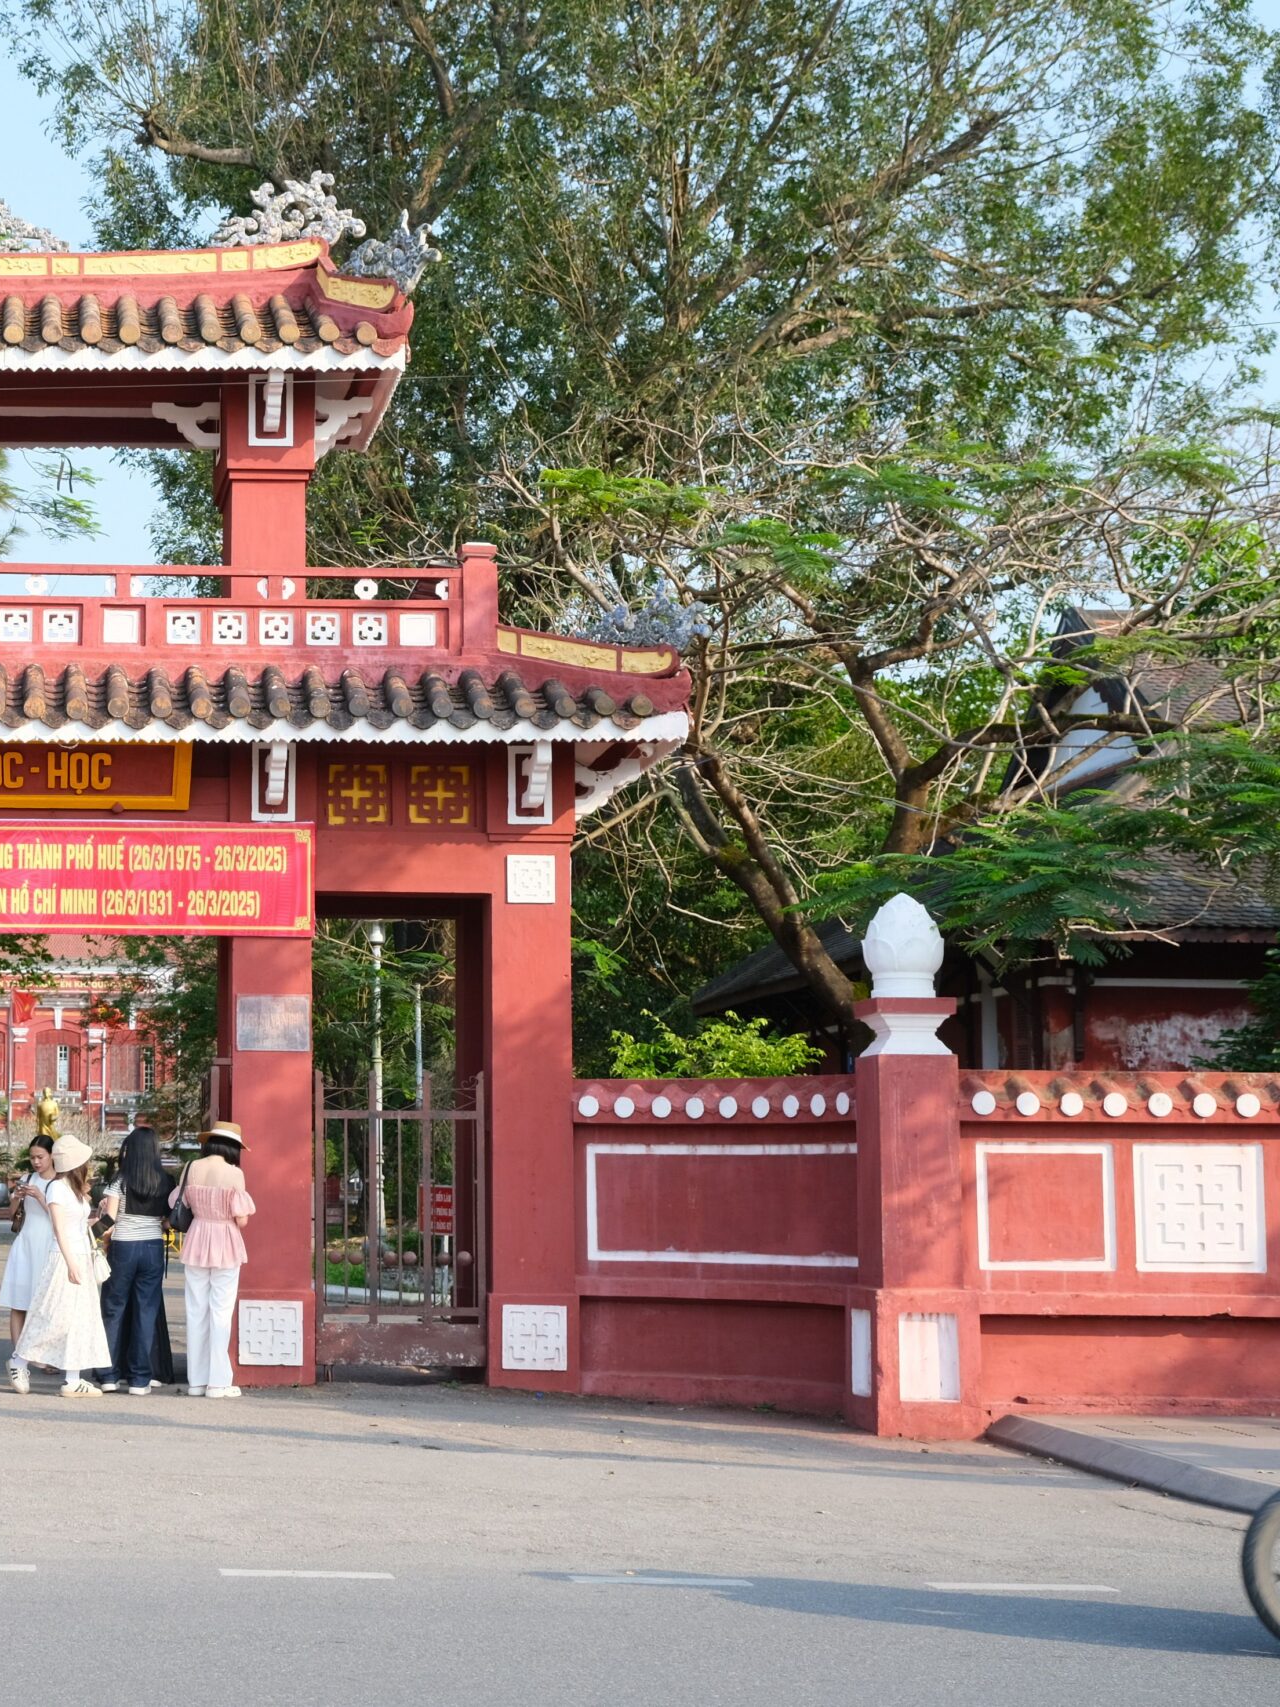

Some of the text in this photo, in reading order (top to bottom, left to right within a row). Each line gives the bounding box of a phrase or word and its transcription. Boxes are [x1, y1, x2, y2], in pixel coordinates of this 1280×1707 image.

[46, 751, 112, 795] HỌC
[17, 838, 62, 870] THÀNH
[66, 835, 94, 870] PHỐ
[98, 836, 125, 871] HUẾ
[129, 844, 201, 873] (26/3/1975
[214, 845, 287, 873] 26/3/2025)
[10, 880, 30, 915] HỒ
[33, 883, 57, 915] CHÍ
[60, 888, 97, 915] MINH
[102, 889, 173, 917] (26/3/1931
[187, 890, 260, 919] 26/3/2025)
